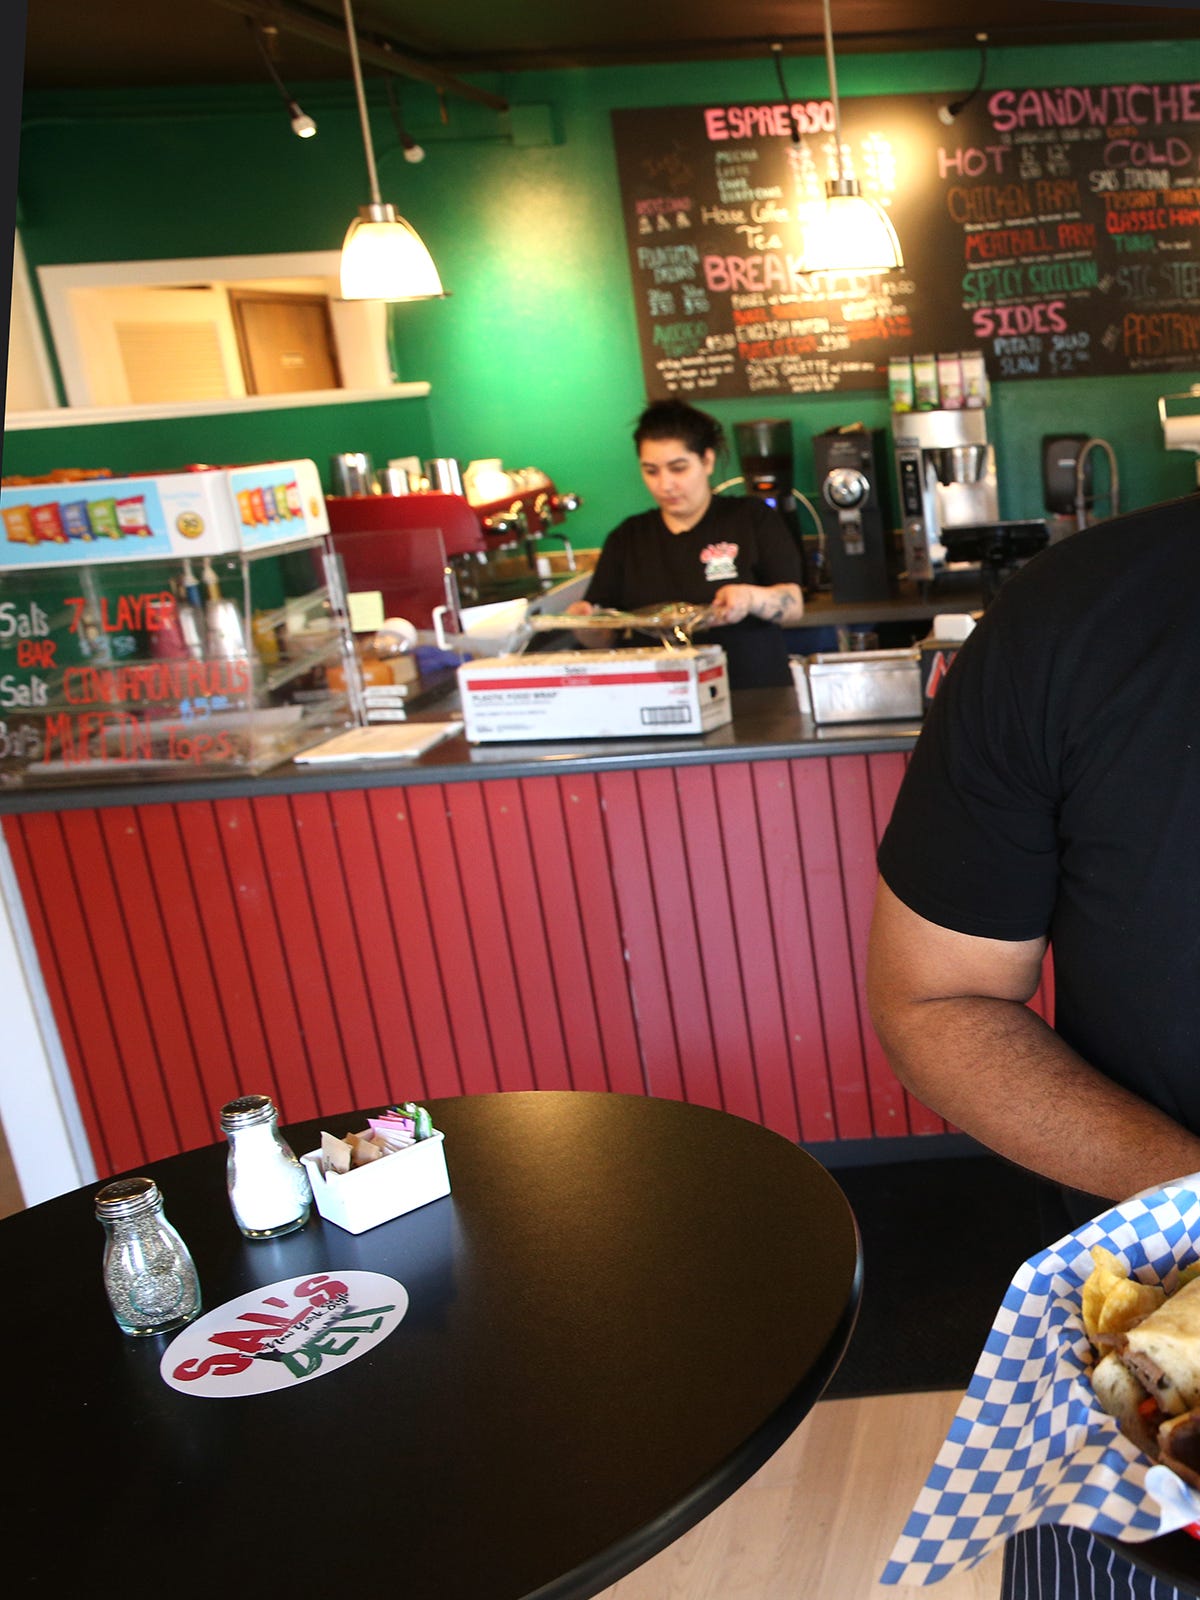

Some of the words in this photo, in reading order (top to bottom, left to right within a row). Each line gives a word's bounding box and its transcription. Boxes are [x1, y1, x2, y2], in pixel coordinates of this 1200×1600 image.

[704, 101, 836, 141] ESPRESSO
[937, 145, 1011, 179] HOT
[1104, 137, 1193, 168] COLD
[948, 183, 1032, 222] CHICKEN
[1035, 180, 1081, 213] PARM
[735, 225, 784, 251] Tea
[965, 229, 1053, 261] MEATBALL
[1057, 223, 1098, 250] PARM
[1106, 210, 1167, 234] CLASSIC
[962, 268, 1024, 303] SPICY
[1029, 261, 1099, 293] SICILIAN
[972, 301, 1068, 338] SIDES
[63, 597, 86, 634] 7
[100, 591, 176, 632] LAYER
[17, 639, 58, 670] BAR
[63, 662, 176, 705] CINNAMON
[178, 660, 249, 697] ROLLS
[43, 710, 153, 767] MUFFIN
[173, 1275, 349, 1382] SAL'S
[281, 1304, 397, 1379] DELI
